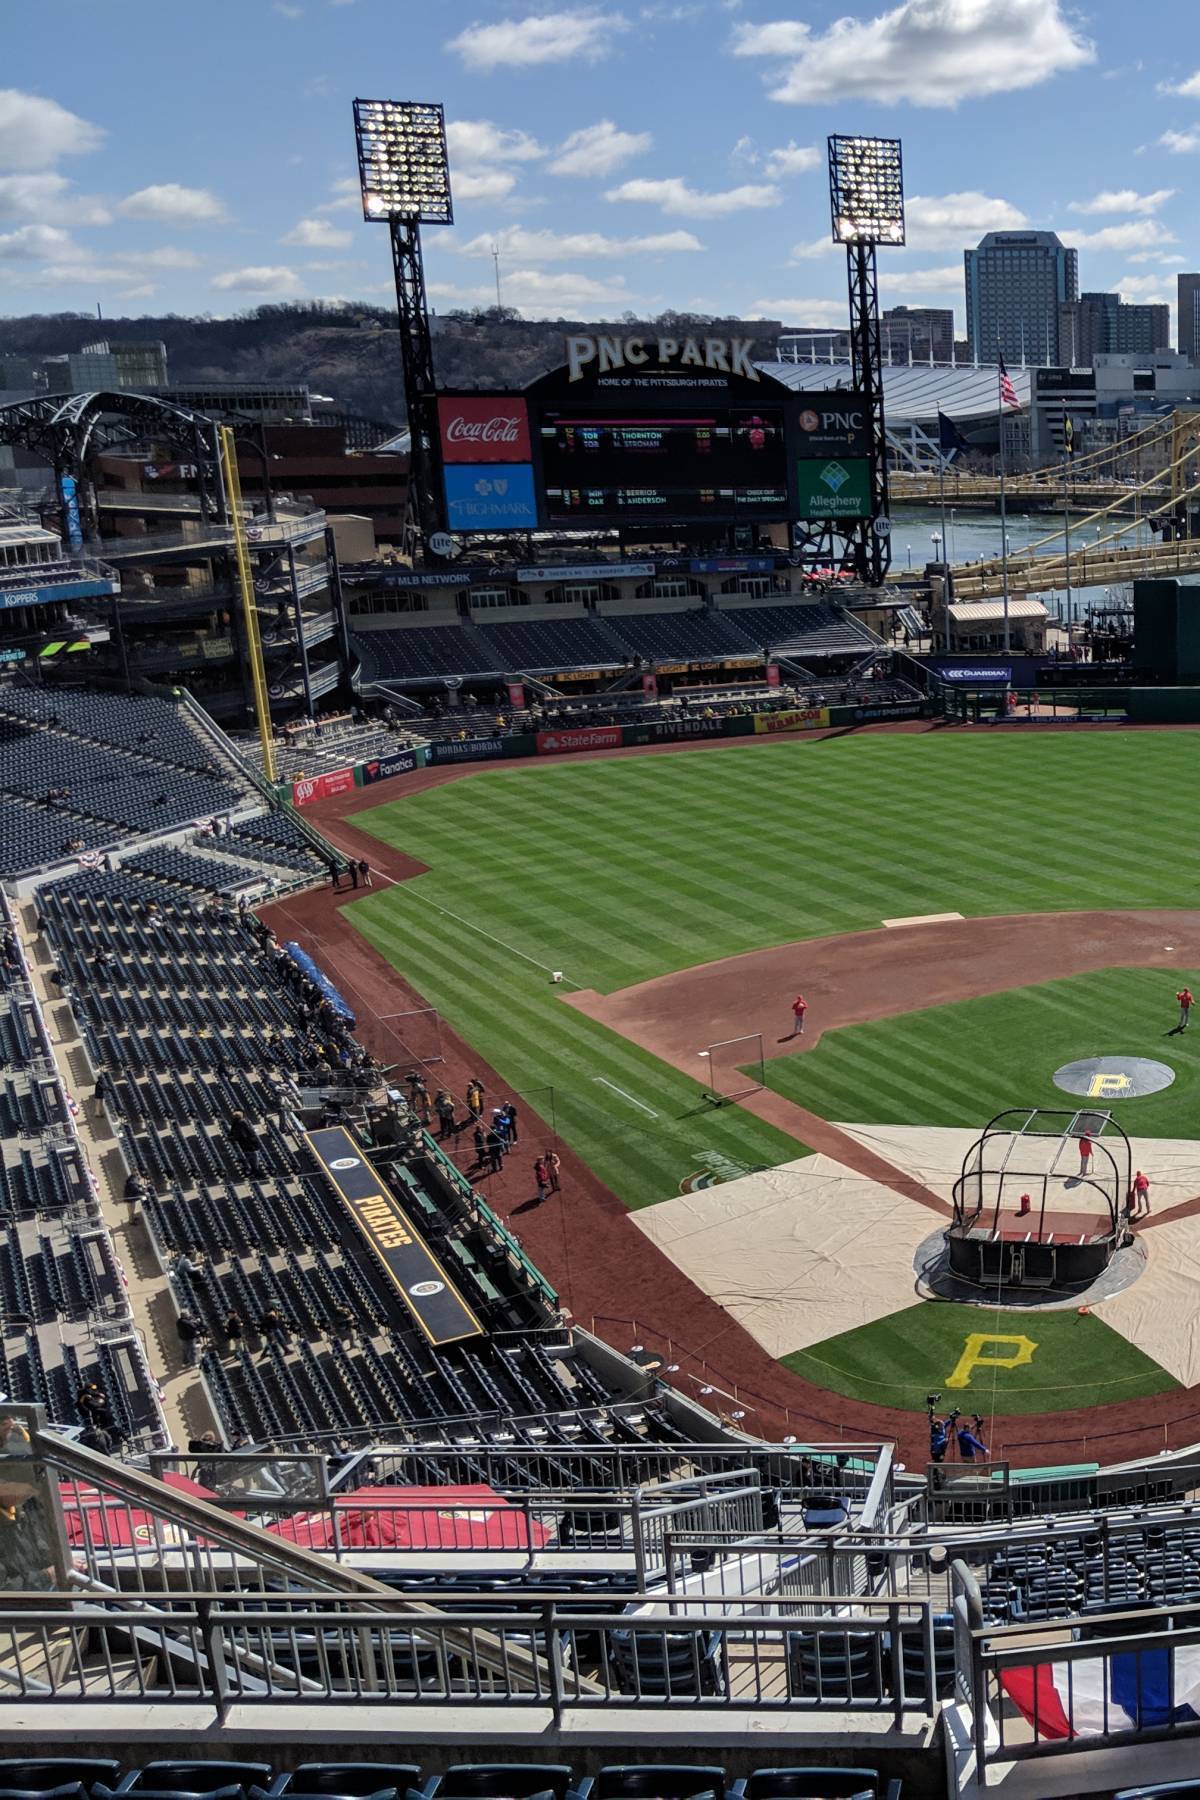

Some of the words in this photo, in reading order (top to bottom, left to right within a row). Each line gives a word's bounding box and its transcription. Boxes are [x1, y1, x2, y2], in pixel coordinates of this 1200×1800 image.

[567, 336, 650, 383] PNC
[657, 337, 761, 383] PARK
[598, 378, 620, 388] HOME
[621, 378, 632, 387] OF
[633, 378, 649, 387] THE
[650, 378, 696, 387] PITTSBURGH
[820, 411, 864, 430] PNC
[583, 432, 599, 440] TOR
[621, 431, 662, 440] THORNTON
[627, 496, 668, 505] ANDERSON
[809, 495, 862, 508] Allegheny
[432, 537, 452, 550] Lite
[398, 575, 420, 586] MLB
[422, 574, 472, 585] NETWORK
[5, 592, 39, 607] KOPPERS
[656, 719, 723, 736] RIVENDALE
[436, 744, 469, 756] BORDAS
[471, 741, 503, 753] BORDAS
[380, 758, 414, 777] Fanatics
[1087, 1073, 1133, 1098] P
[354, 1194, 413, 1249] PIRATES
[945, 1332, 1039, 1389] P
